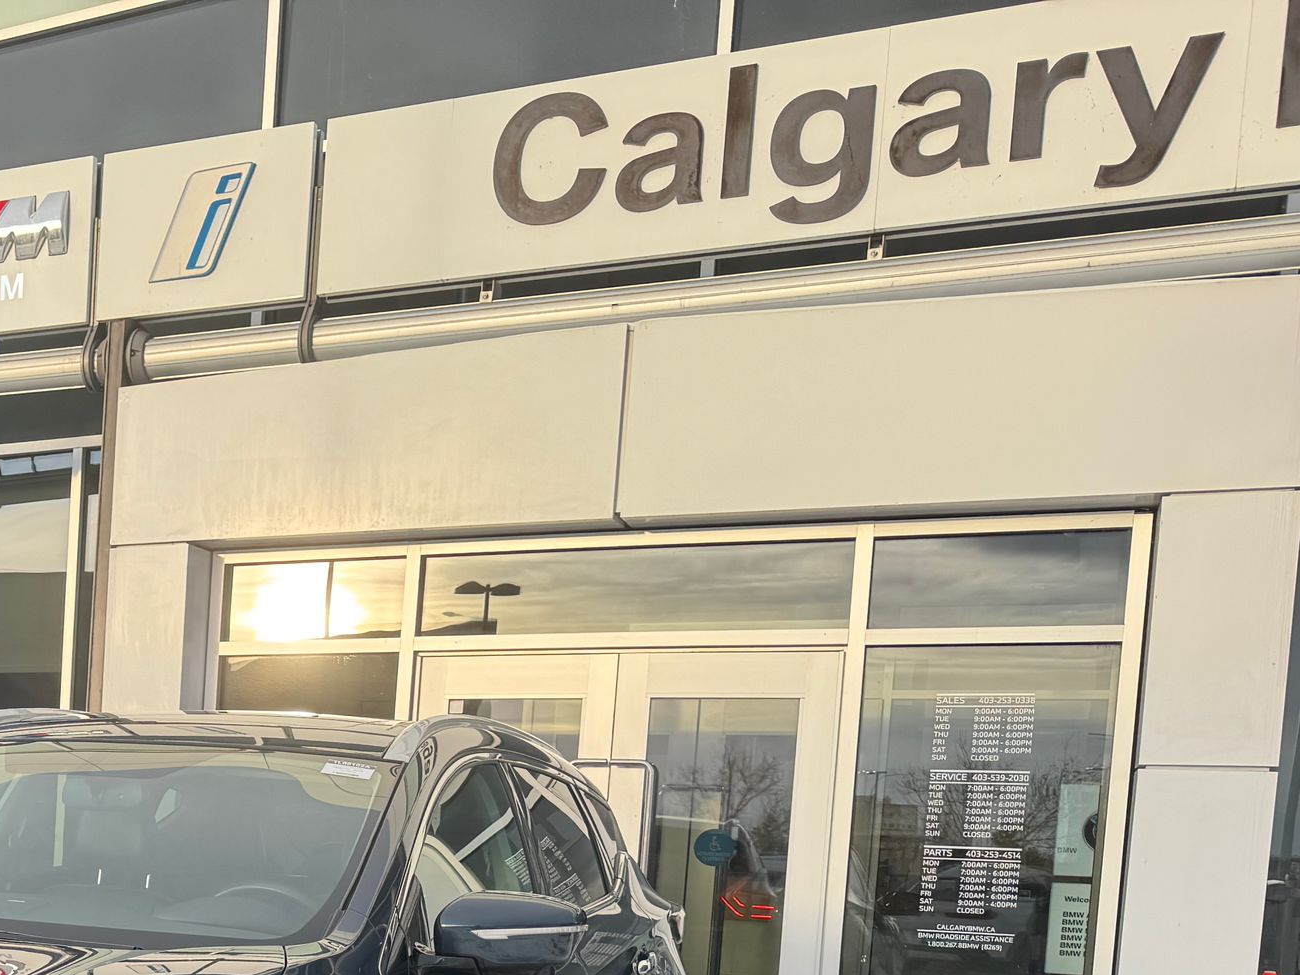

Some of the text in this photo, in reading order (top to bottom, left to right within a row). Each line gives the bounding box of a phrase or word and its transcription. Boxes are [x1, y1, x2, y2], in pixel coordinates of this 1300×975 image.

[493, 31, 1225, 226] Calgary
[0, 273, 24, 302] M
[972, 774, 1029, 782] 403-539-2030
[966, 850, 1021, 859] 403-253-4514
[937, 924, 995, 933] CALGARYBMW.CA
[970, 935, 1014, 943] ASSISTANCE
